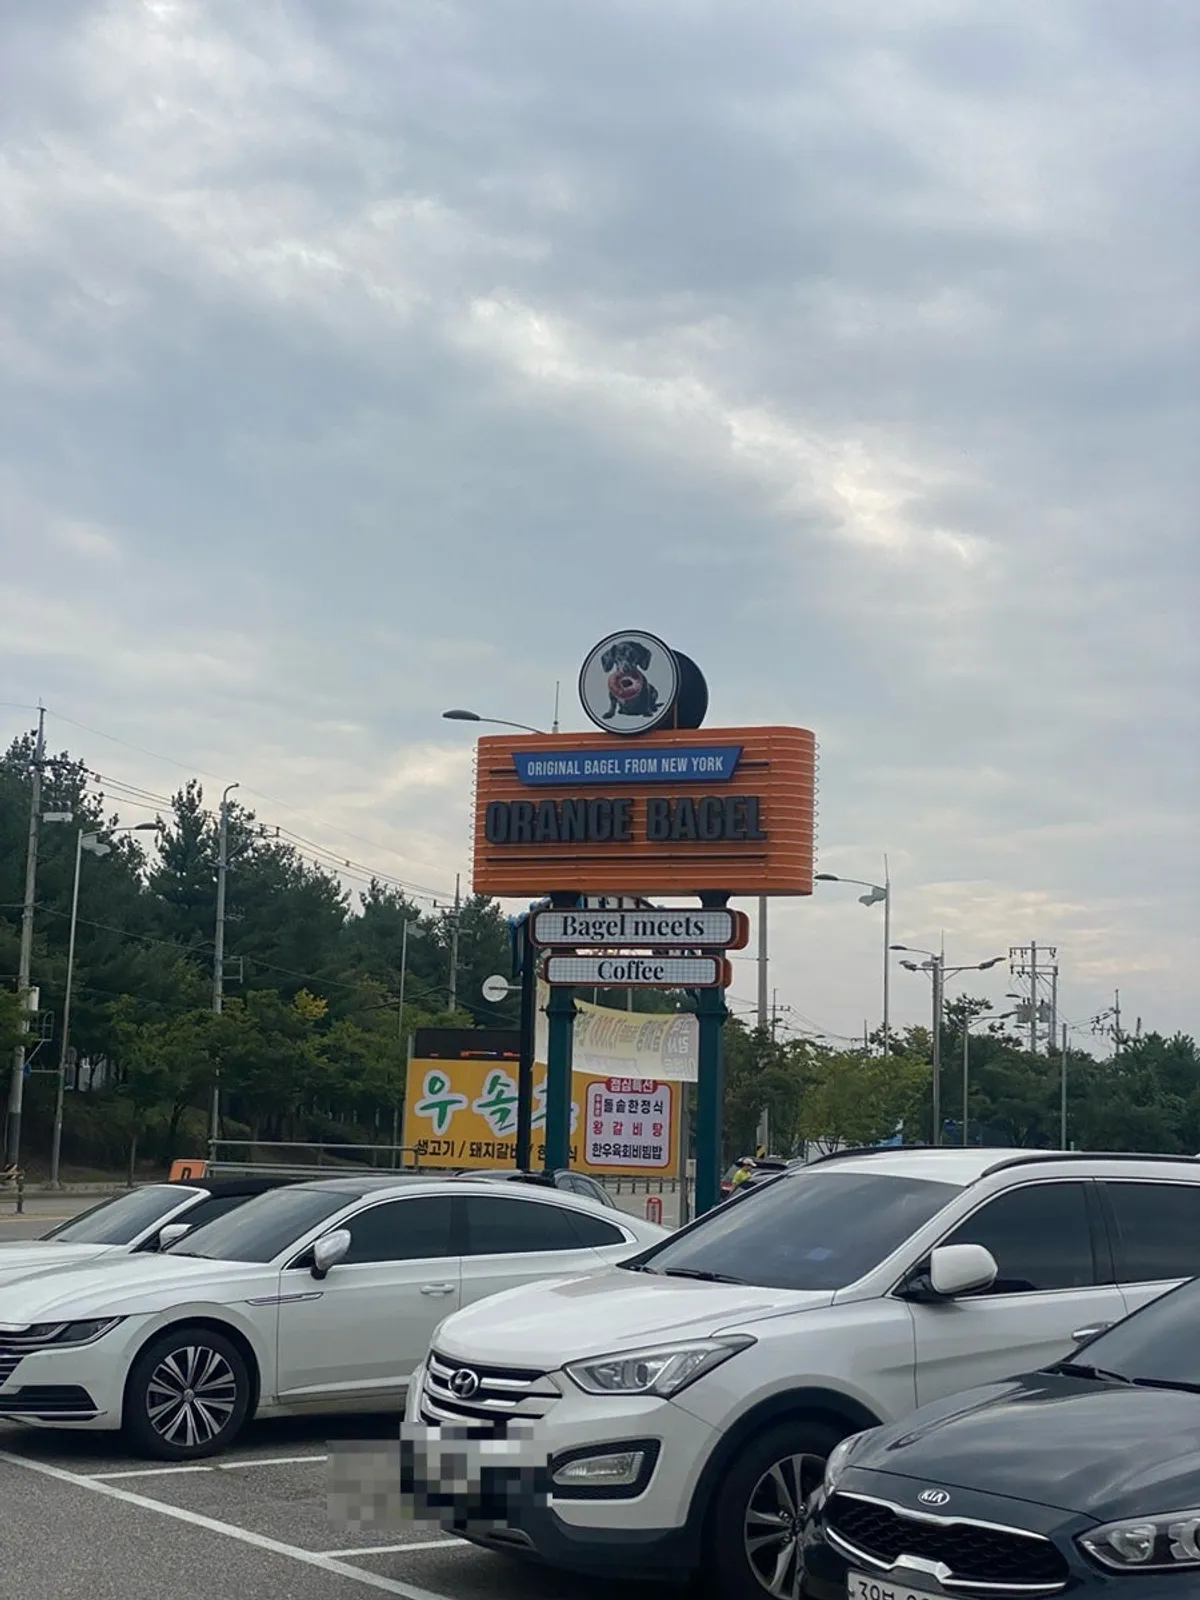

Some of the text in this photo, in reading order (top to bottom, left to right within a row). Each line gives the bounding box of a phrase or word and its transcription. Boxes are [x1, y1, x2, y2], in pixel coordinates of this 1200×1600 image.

[527, 756, 724, 777] ORIGINAL BAGEL FROM NEW YORK
[485, 795, 768, 845] ORANGE BAGEL
[562, 914, 704, 941] Bagel meets
[597, 960, 664, 981] Coffee
[417, 1139, 455, 1158] 생고기
